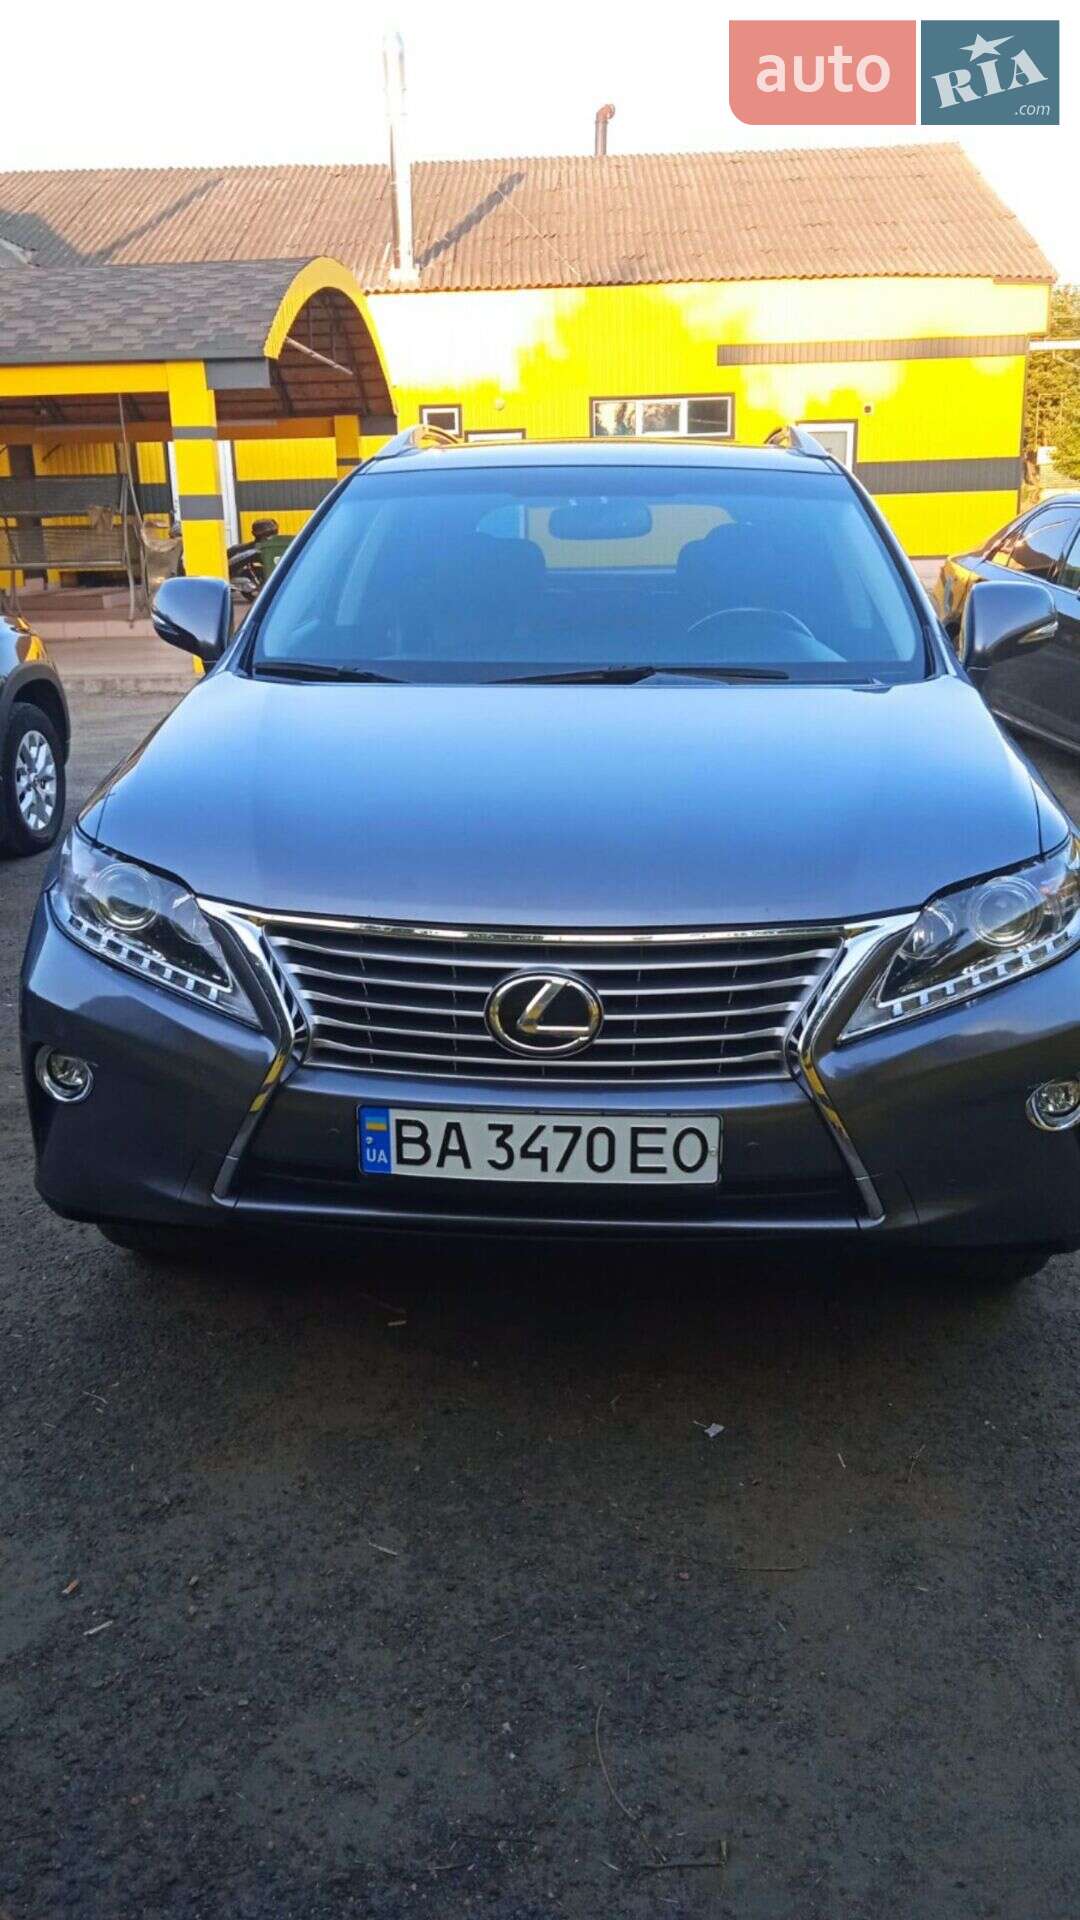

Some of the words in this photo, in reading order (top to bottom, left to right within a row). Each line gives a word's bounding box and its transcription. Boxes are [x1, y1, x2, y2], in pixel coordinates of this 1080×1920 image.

[366, 1149, 388, 1164] UA
[395, 1118, 472, 1169] BA
[487, 1124, 616, 1174] 3470
[629, 1126, 709, 1174] EO
